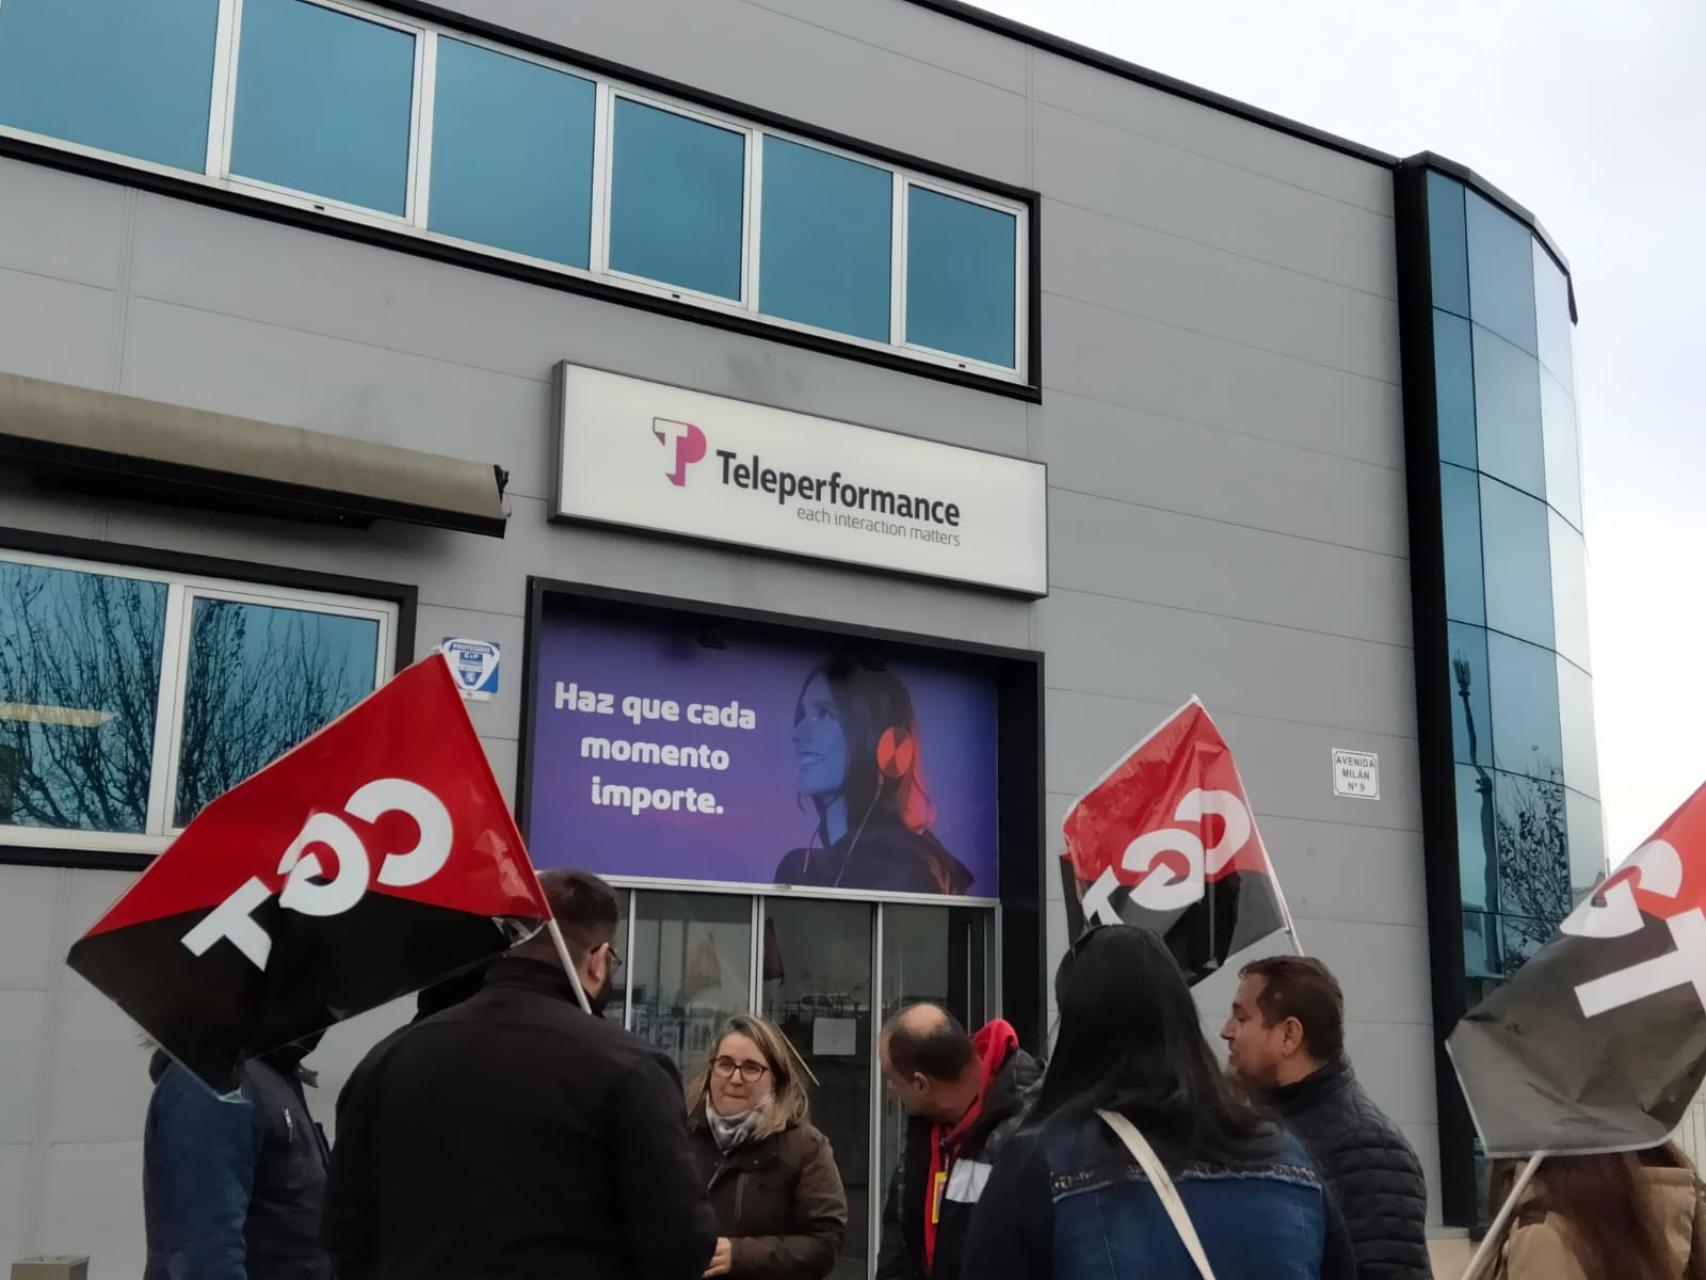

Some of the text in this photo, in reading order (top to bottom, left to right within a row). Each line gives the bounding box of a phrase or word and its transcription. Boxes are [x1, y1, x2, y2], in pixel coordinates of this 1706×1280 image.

[716, 449, 960, 527] Teleperformance
[797, 507, 960, 547] each interaction matters
[555, 681, 756, 730] Haz que cada
[581, 736, 730, 771] momento
[1336, 755, 1375, 768] AVENIDA
[591, 775, 724, 816] importe.
